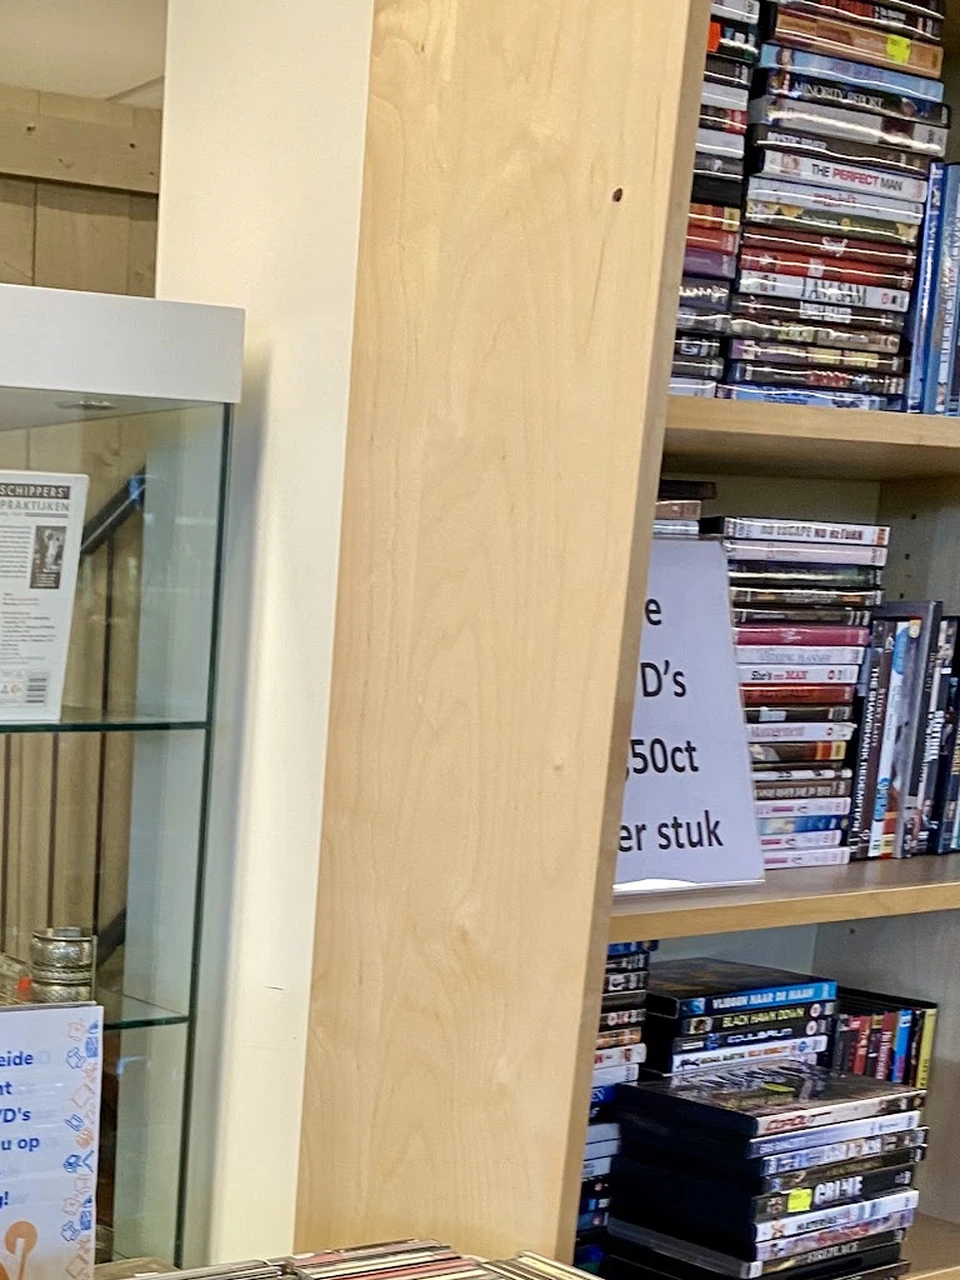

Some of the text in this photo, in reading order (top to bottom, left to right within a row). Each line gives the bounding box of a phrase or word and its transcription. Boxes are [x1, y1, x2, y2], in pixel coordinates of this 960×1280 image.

[811, 163, 903, 191] THE PERFECT MAN
[848, 665, 881, 833] THE SHAWSHANK REDEMPTION
[657, 810, 725, 850] stuk
[775, 991, 788, 1002] DE
[722, 1007, 807, 1028] BLACK HAWK DOWN
[1, 1139, 12, 1152] u
[17, 1136, 41, 1152] op
[814, 1176, 863, 1206] CRIME
